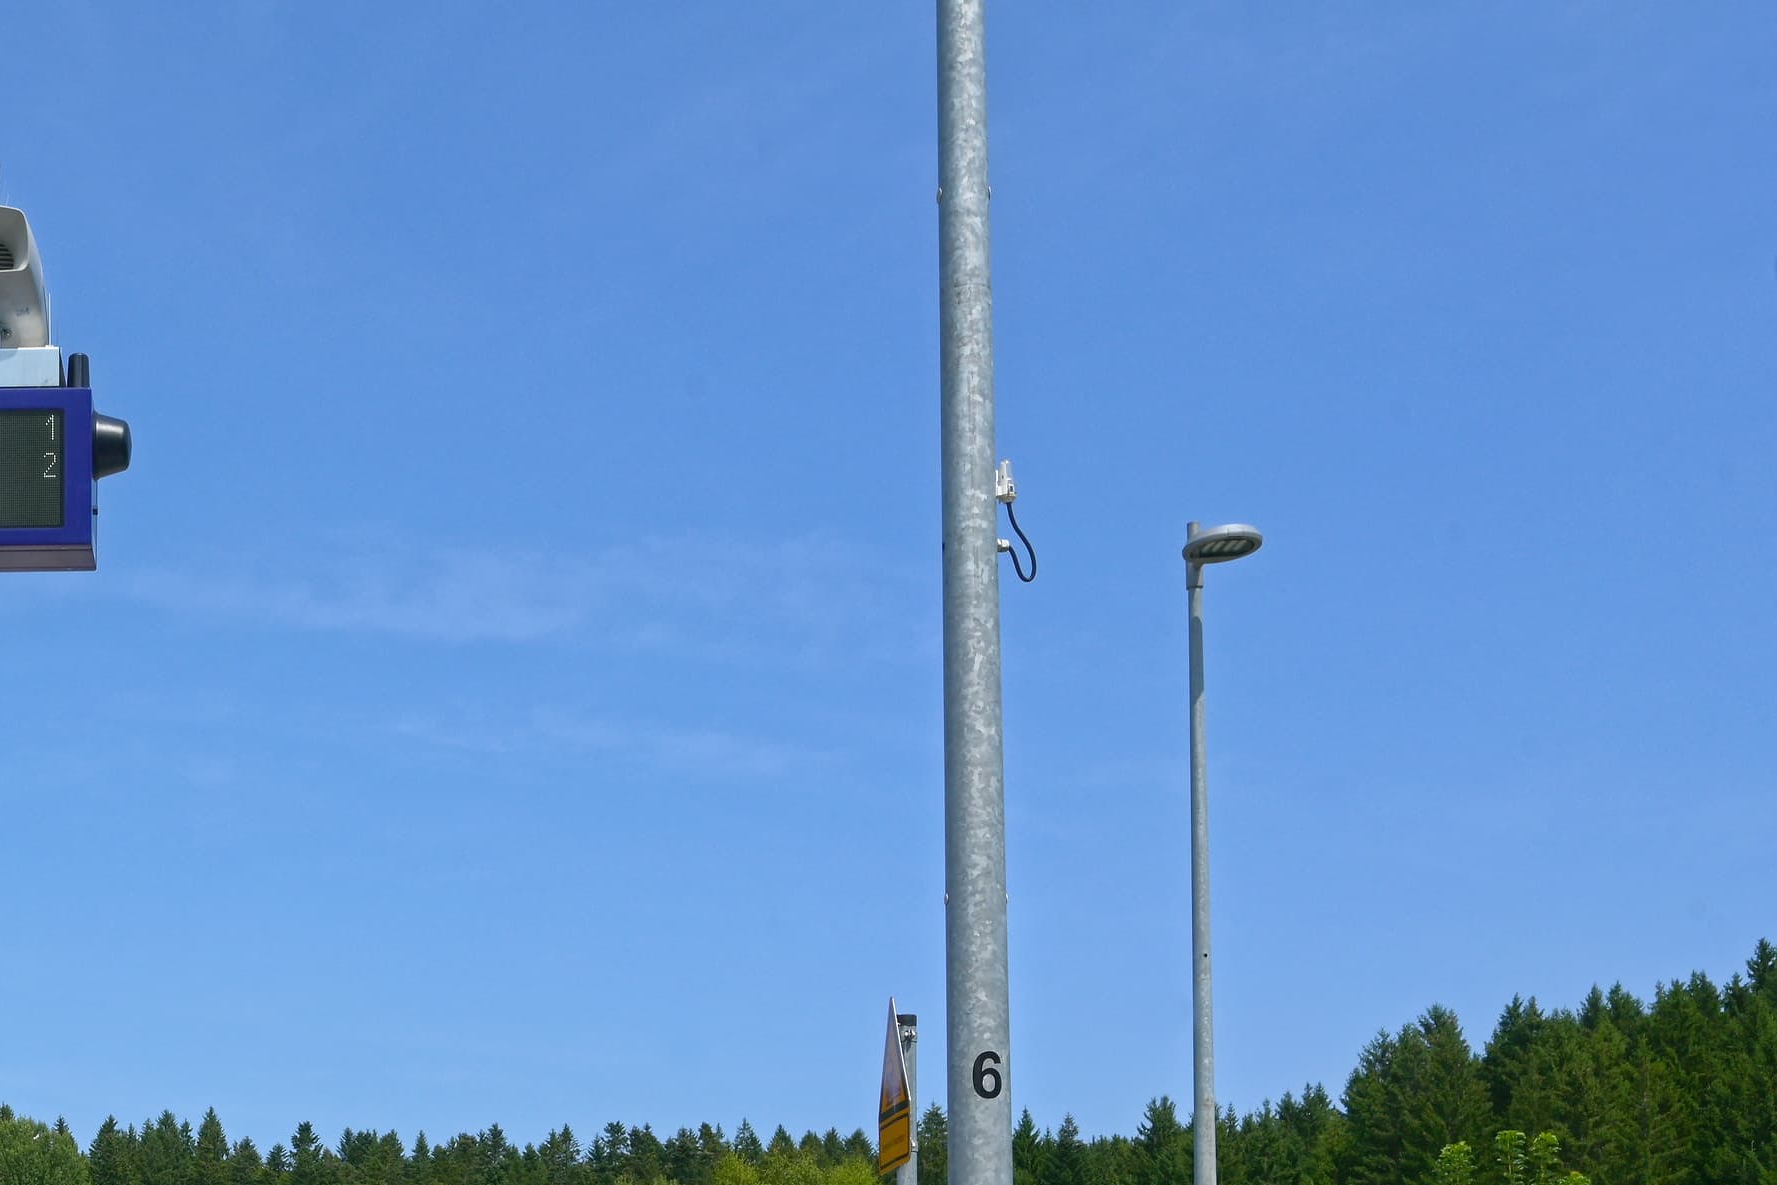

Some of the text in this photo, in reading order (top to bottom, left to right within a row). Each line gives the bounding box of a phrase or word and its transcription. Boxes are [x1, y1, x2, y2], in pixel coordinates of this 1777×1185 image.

[45, 414, 55, 441] 1
[43, 452, 57, 478] 2
[972, 1051, 1002, 1099] 6
